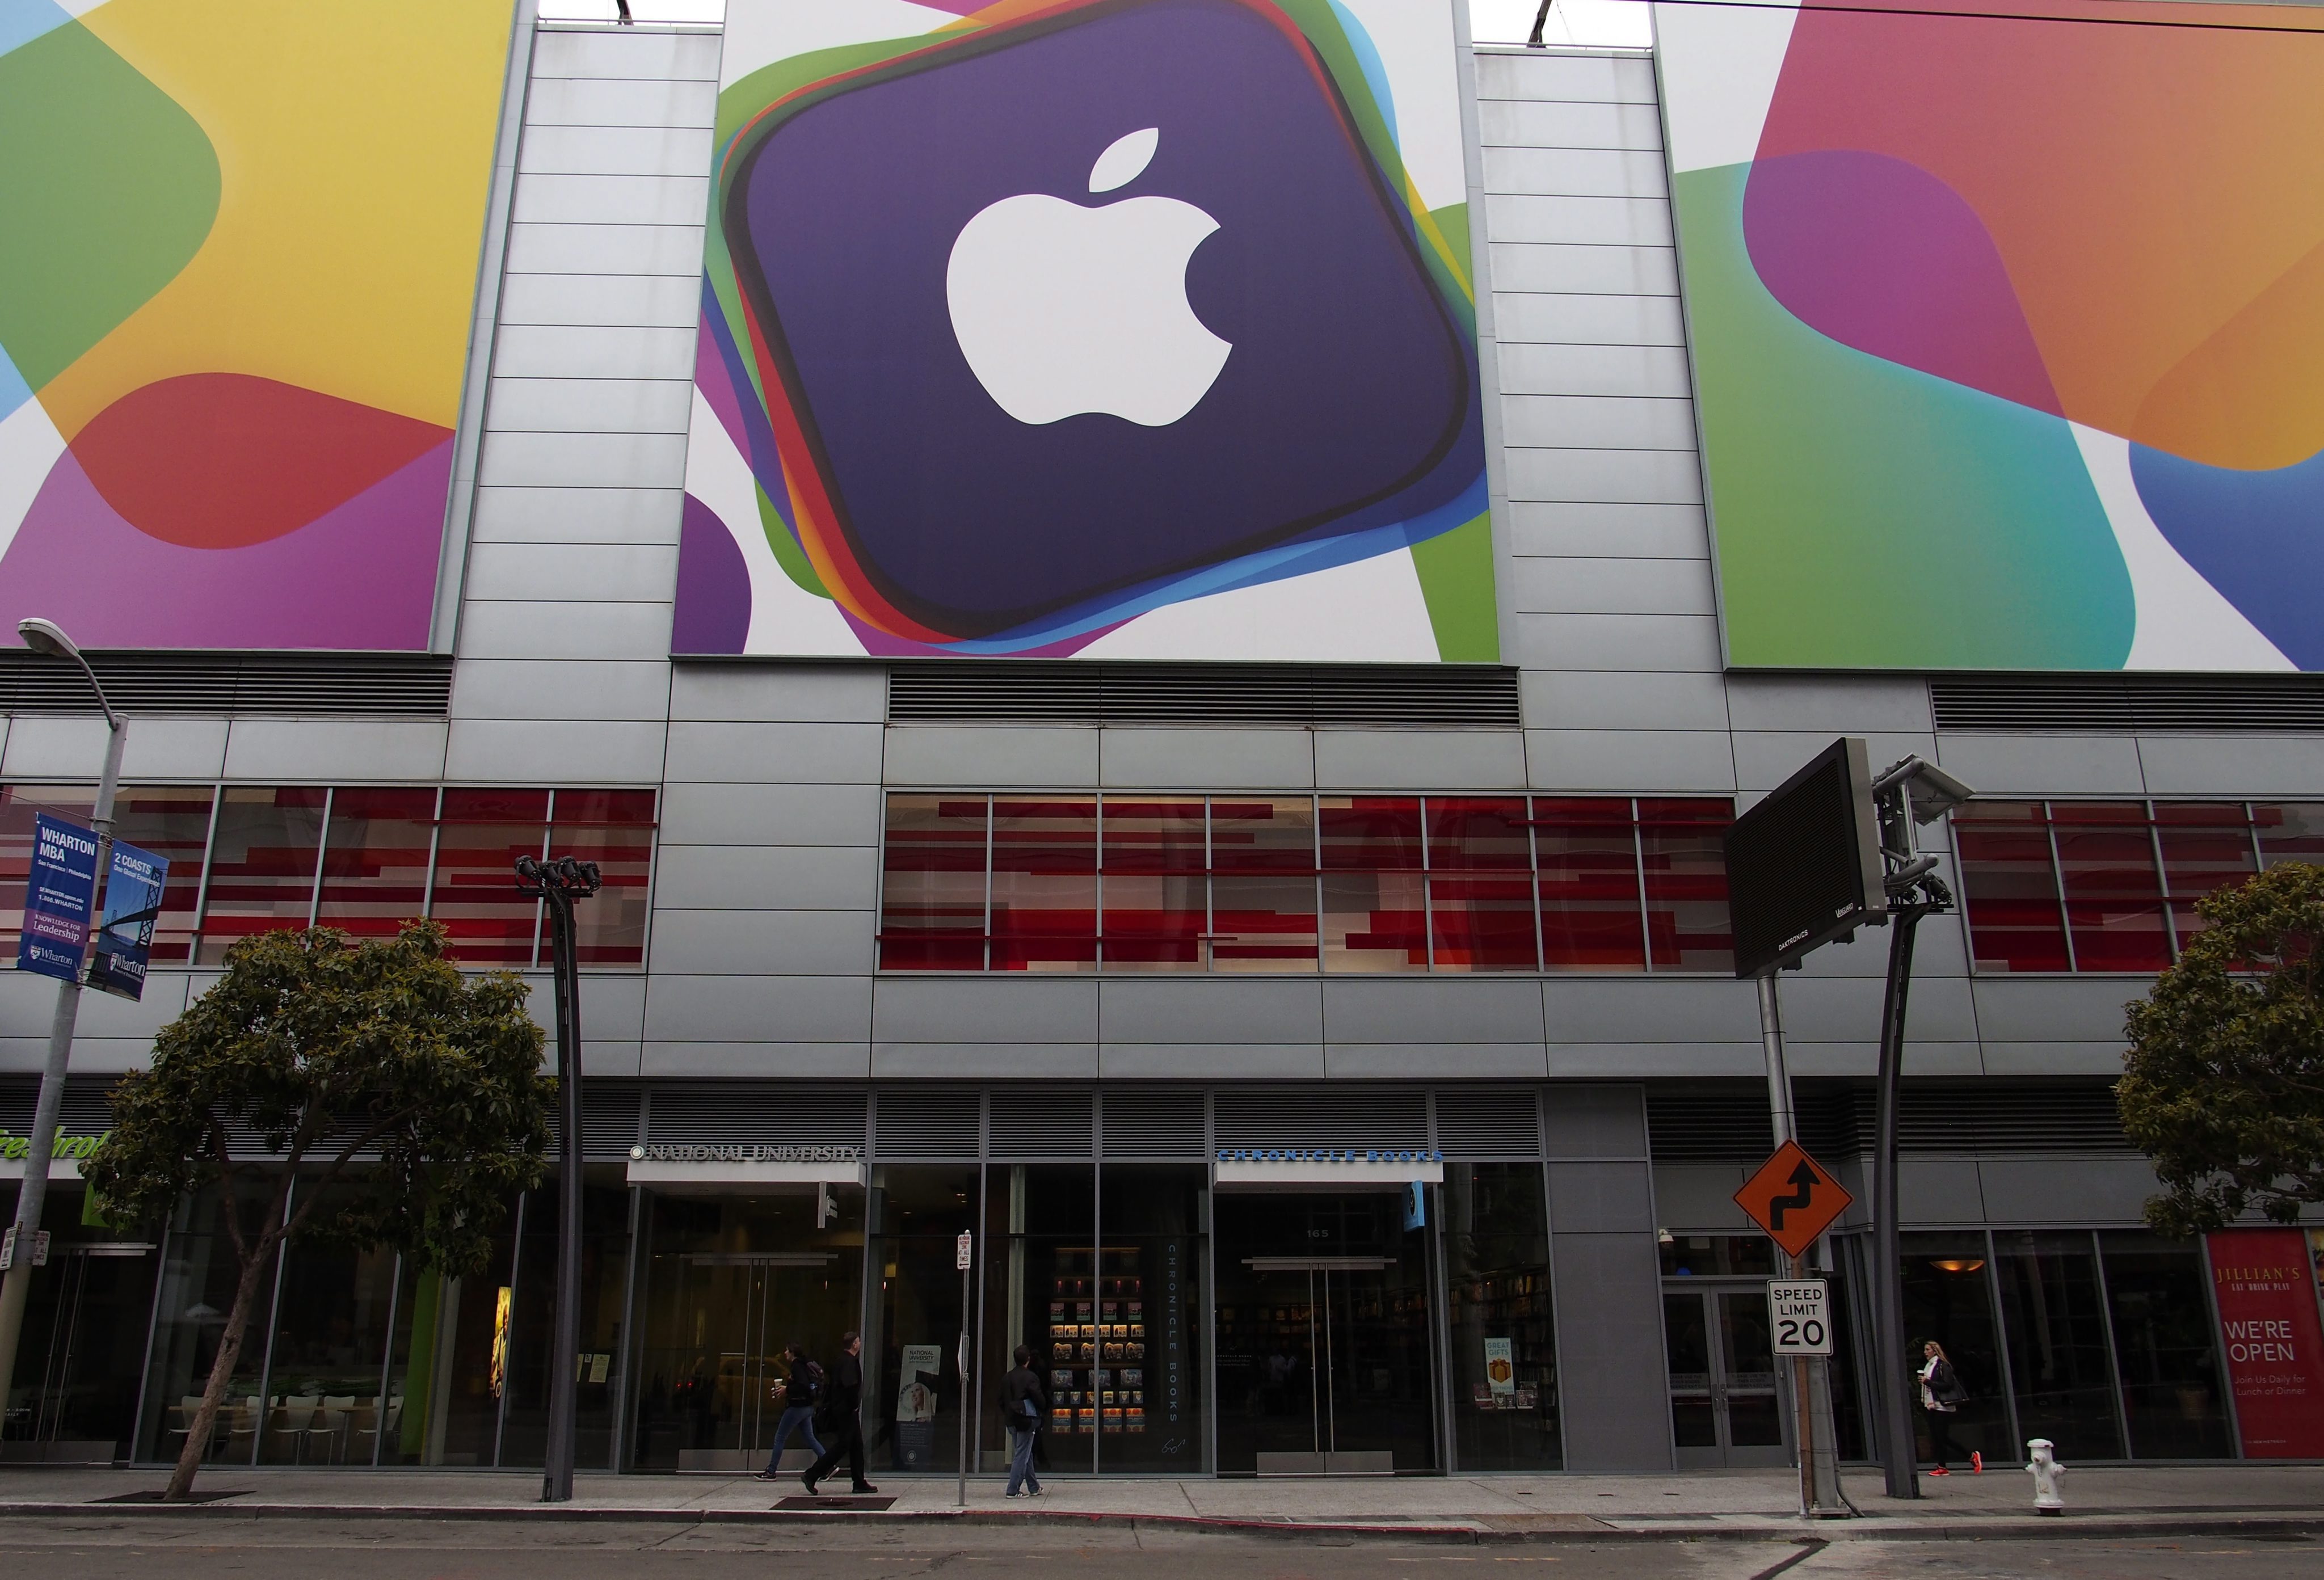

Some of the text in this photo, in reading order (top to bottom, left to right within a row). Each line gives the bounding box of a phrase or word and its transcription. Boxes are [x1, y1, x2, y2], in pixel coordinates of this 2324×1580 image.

[41, 827, 95, 856] WHARTON
[39, 842, 65, 862] MBA
[47, 862, 66, 873] Francisco
[114, 864, 123, 873] One
[123, 867, 137, 878] Global
[115, 853, 151, 875] 2 COASTS
[35, 914, 69, 928] KNOWLEDGE
[33, 921, 80, 943] Leadership
[1778, 929, 1809, 951] DAKTRONICS
[41, 947, 73, 965] Wharton
[117, 954, 146, 976] Wharton
[649, 1144, 861, 1162] NATIONAL UNIVERSITY
[1217, 1149, 1445, 1162] CHRONICLE BOOKS
[1307, 1229, 1329, 1238] 165
[2216, 1267, 2301, 1284] JILLIAN'S
[1774, 1289, 1822, 1300] SPEED
[2231, 1282, 2291, 1292] EAT DRINK PLAY
[1168, 1244, 1177, 1350] CHRONICLE
[1780, 1304, 1818, 1316] LIMIT
[1778, 1320, 1824, 1346] 20
[2224, 1320, 2293, 1339] WE'RE
[2230, 1342, 2295, 1362] OPEN
[2235, 1373, 2306, 1385] Join Us Daily for
[2237, 1388, 2263, 1397] Lunch
[2276, 1386, 2306, 1396] Dinner
